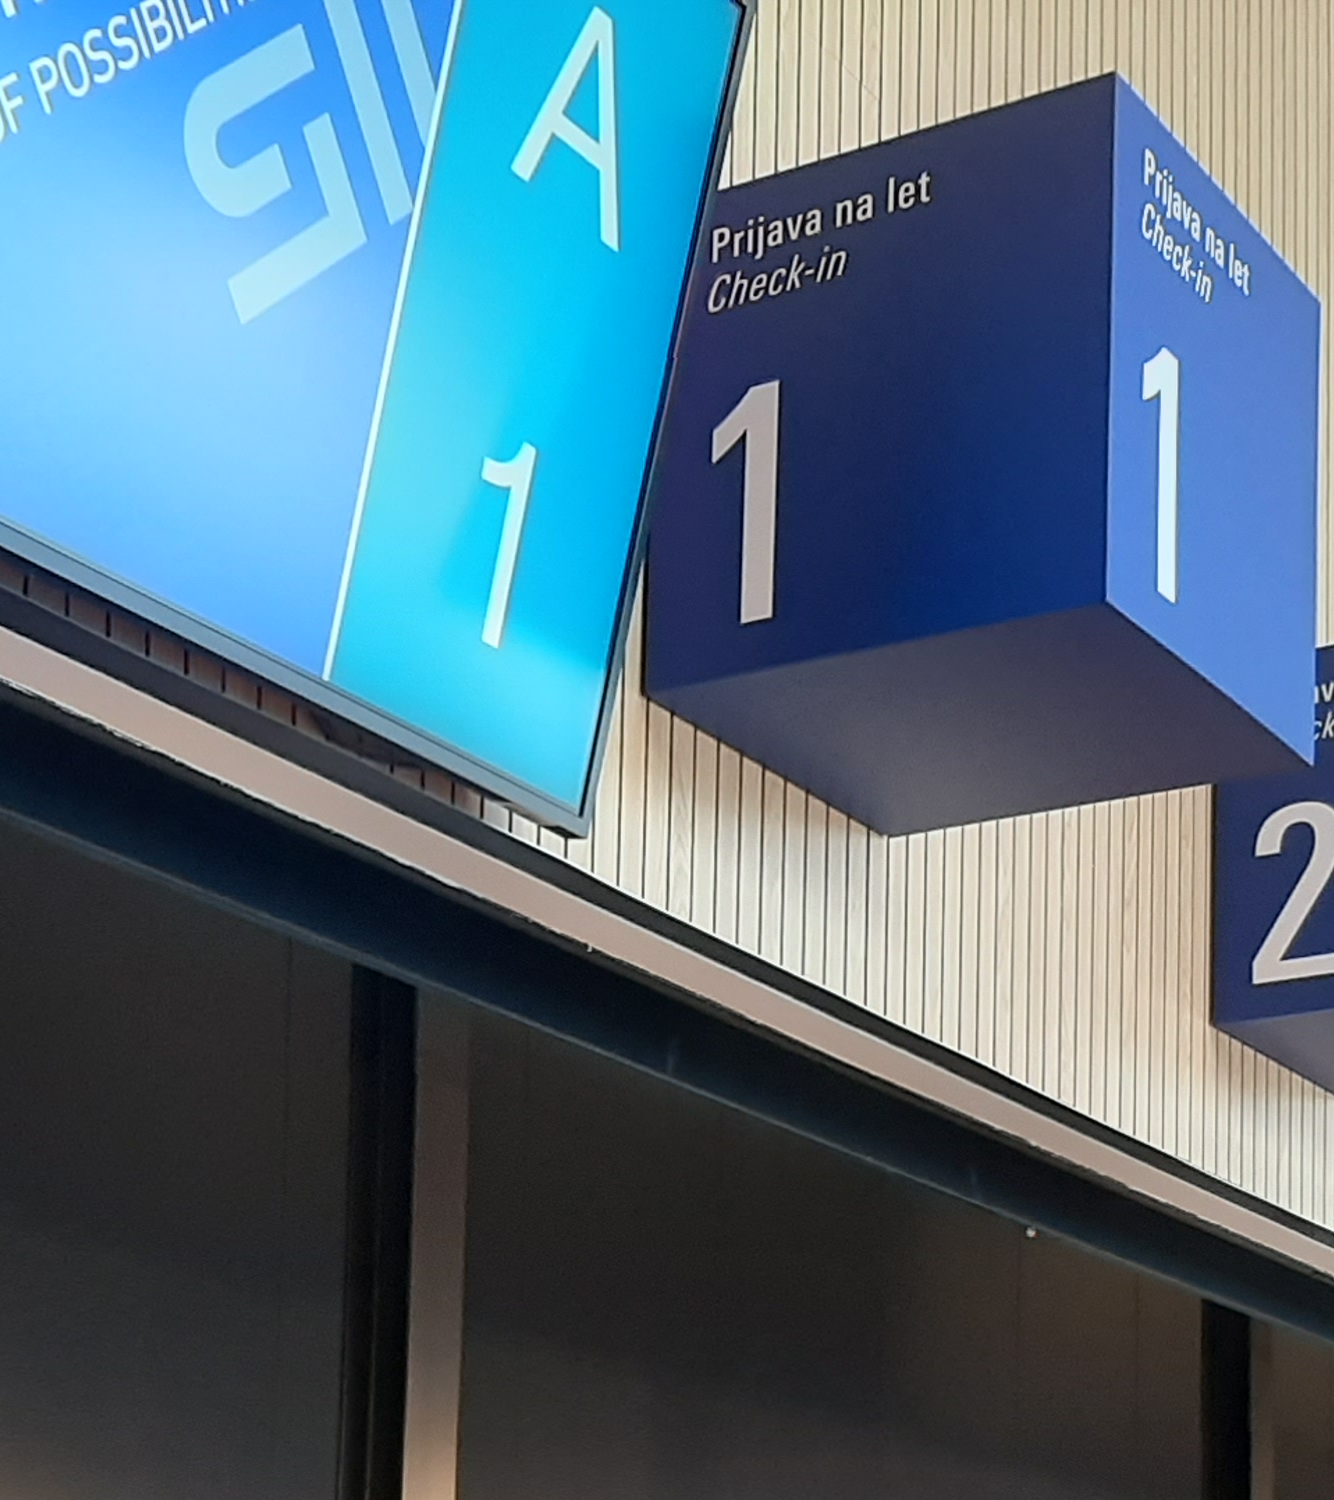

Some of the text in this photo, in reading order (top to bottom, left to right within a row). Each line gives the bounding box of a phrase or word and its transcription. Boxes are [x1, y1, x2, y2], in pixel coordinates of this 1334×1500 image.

[28, 0, 255, 115] POSSIBIL
[510, 5, 620, 253] A
[707, 245, 847, 314] Check-in
[711, 170, 931, 264] Prijava na let
[1141, 202, 1213, 303] Check-in
[1143, 147, 1250, 297] Prijava na let
[481, 441, 537, 649] 1
[711, 379, 780, 624] 1
[1142, 345, 1179, 604] 1
